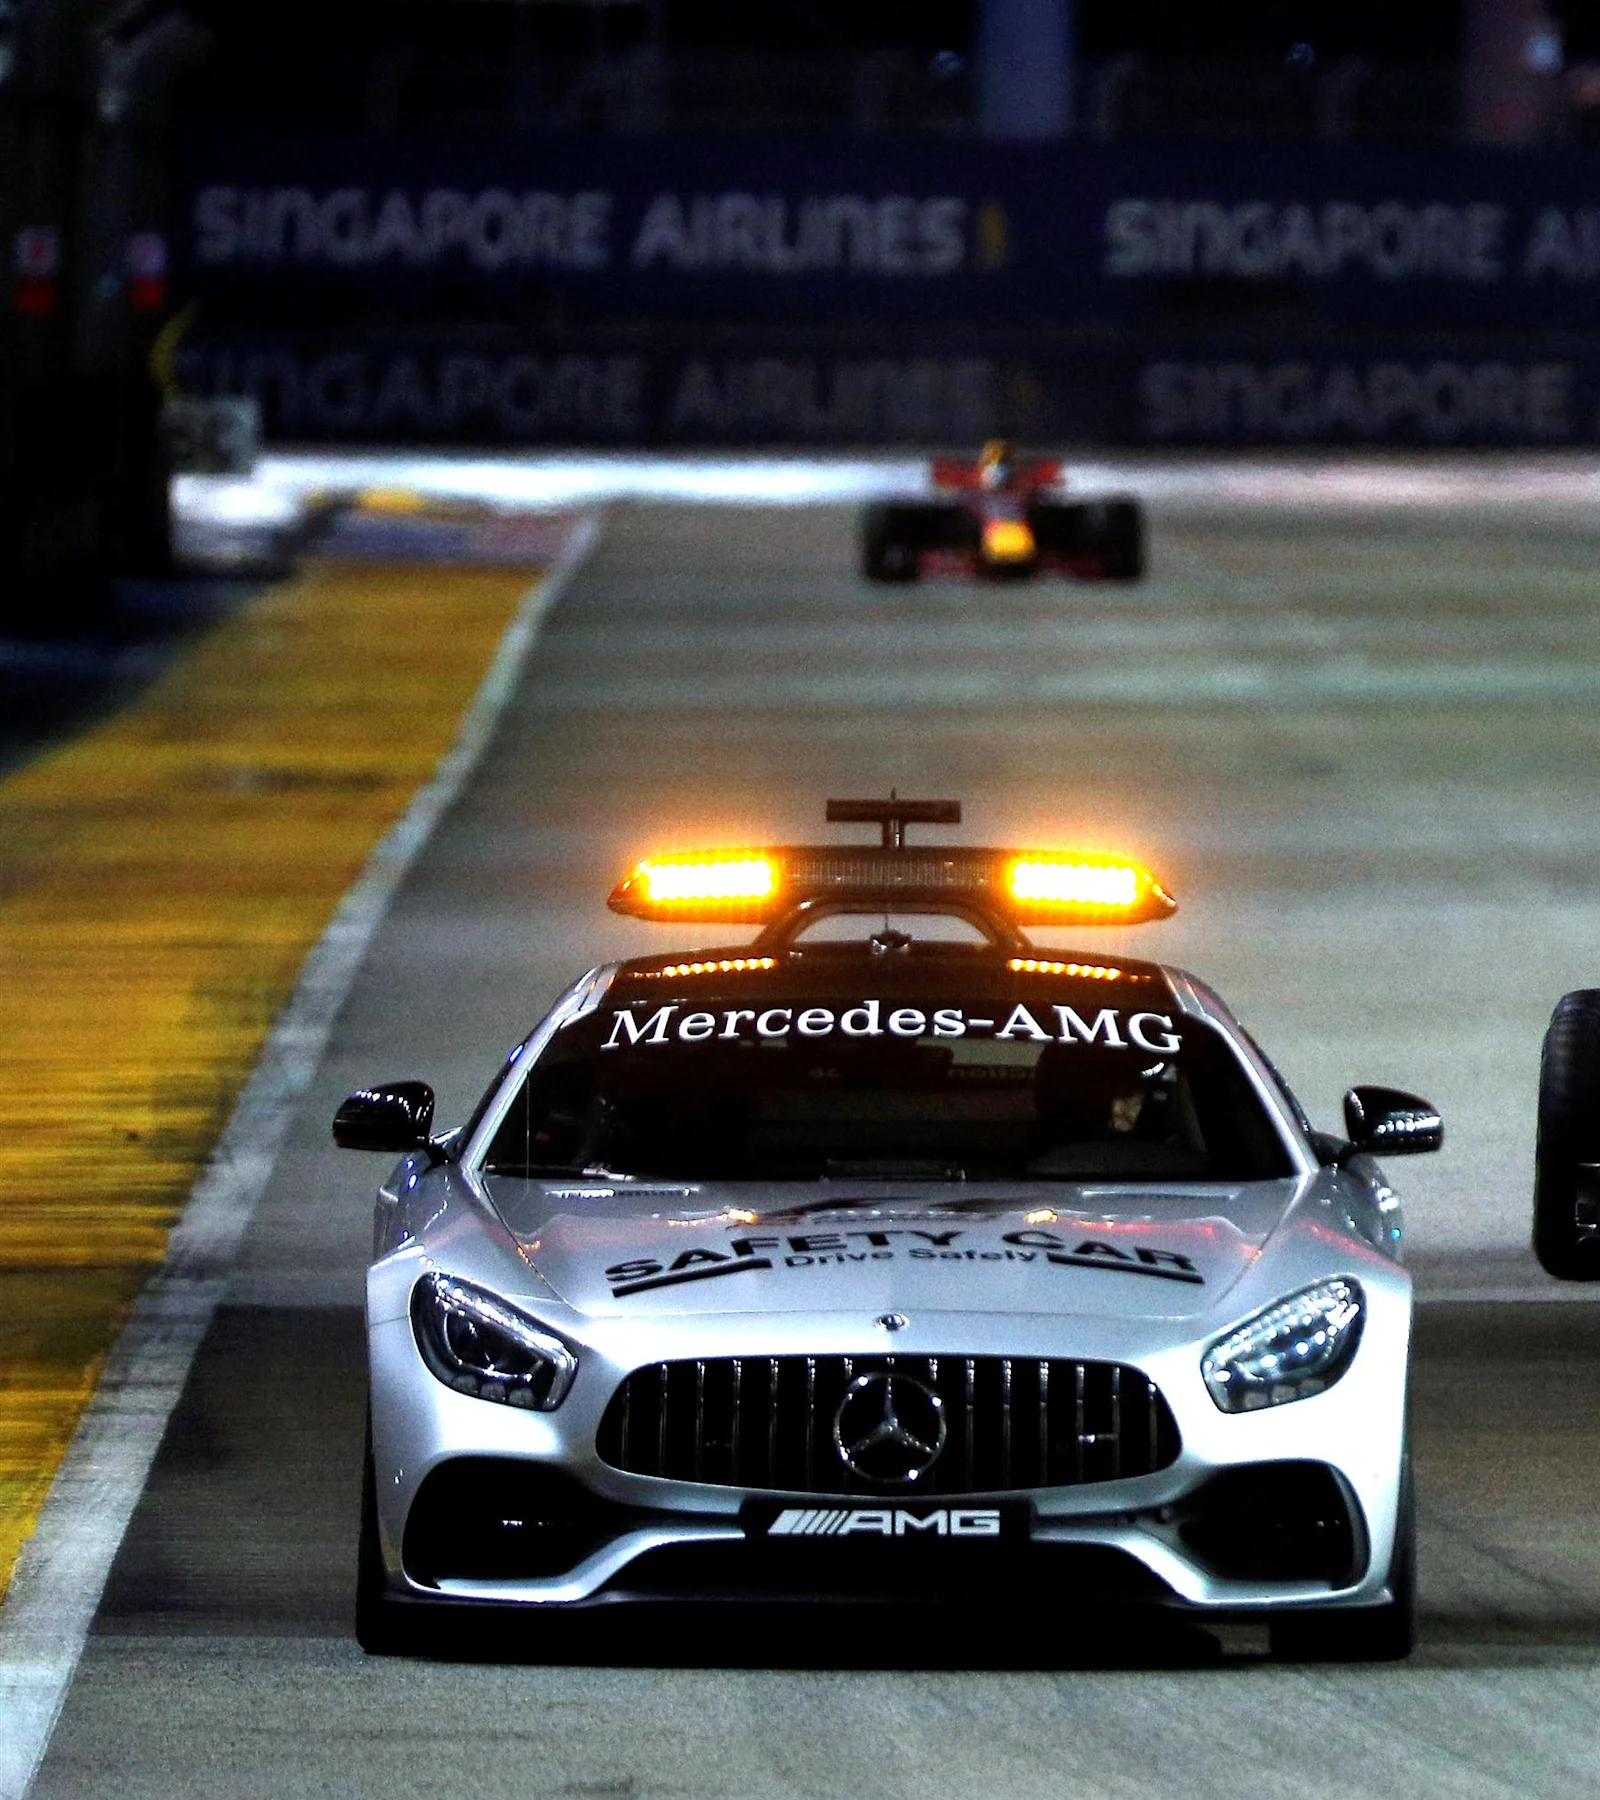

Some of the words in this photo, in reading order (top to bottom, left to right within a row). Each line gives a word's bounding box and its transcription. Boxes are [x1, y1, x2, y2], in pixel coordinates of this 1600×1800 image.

[196, 184, 613, 272] SINGAPORE
[631, 191, 970, 277] AIRLINES
[1104, 199, 1505, 280] SINGAPORE
[600, 999, 1184, 1055] Mercedes-AMG
[604, 1229, 963, 1282] SAFETY
[1002, 1230, 1196, 1272] CAR
[785, 1250, 894, 1267] Drive
[907, 1248, 1037, 1262] Safely
